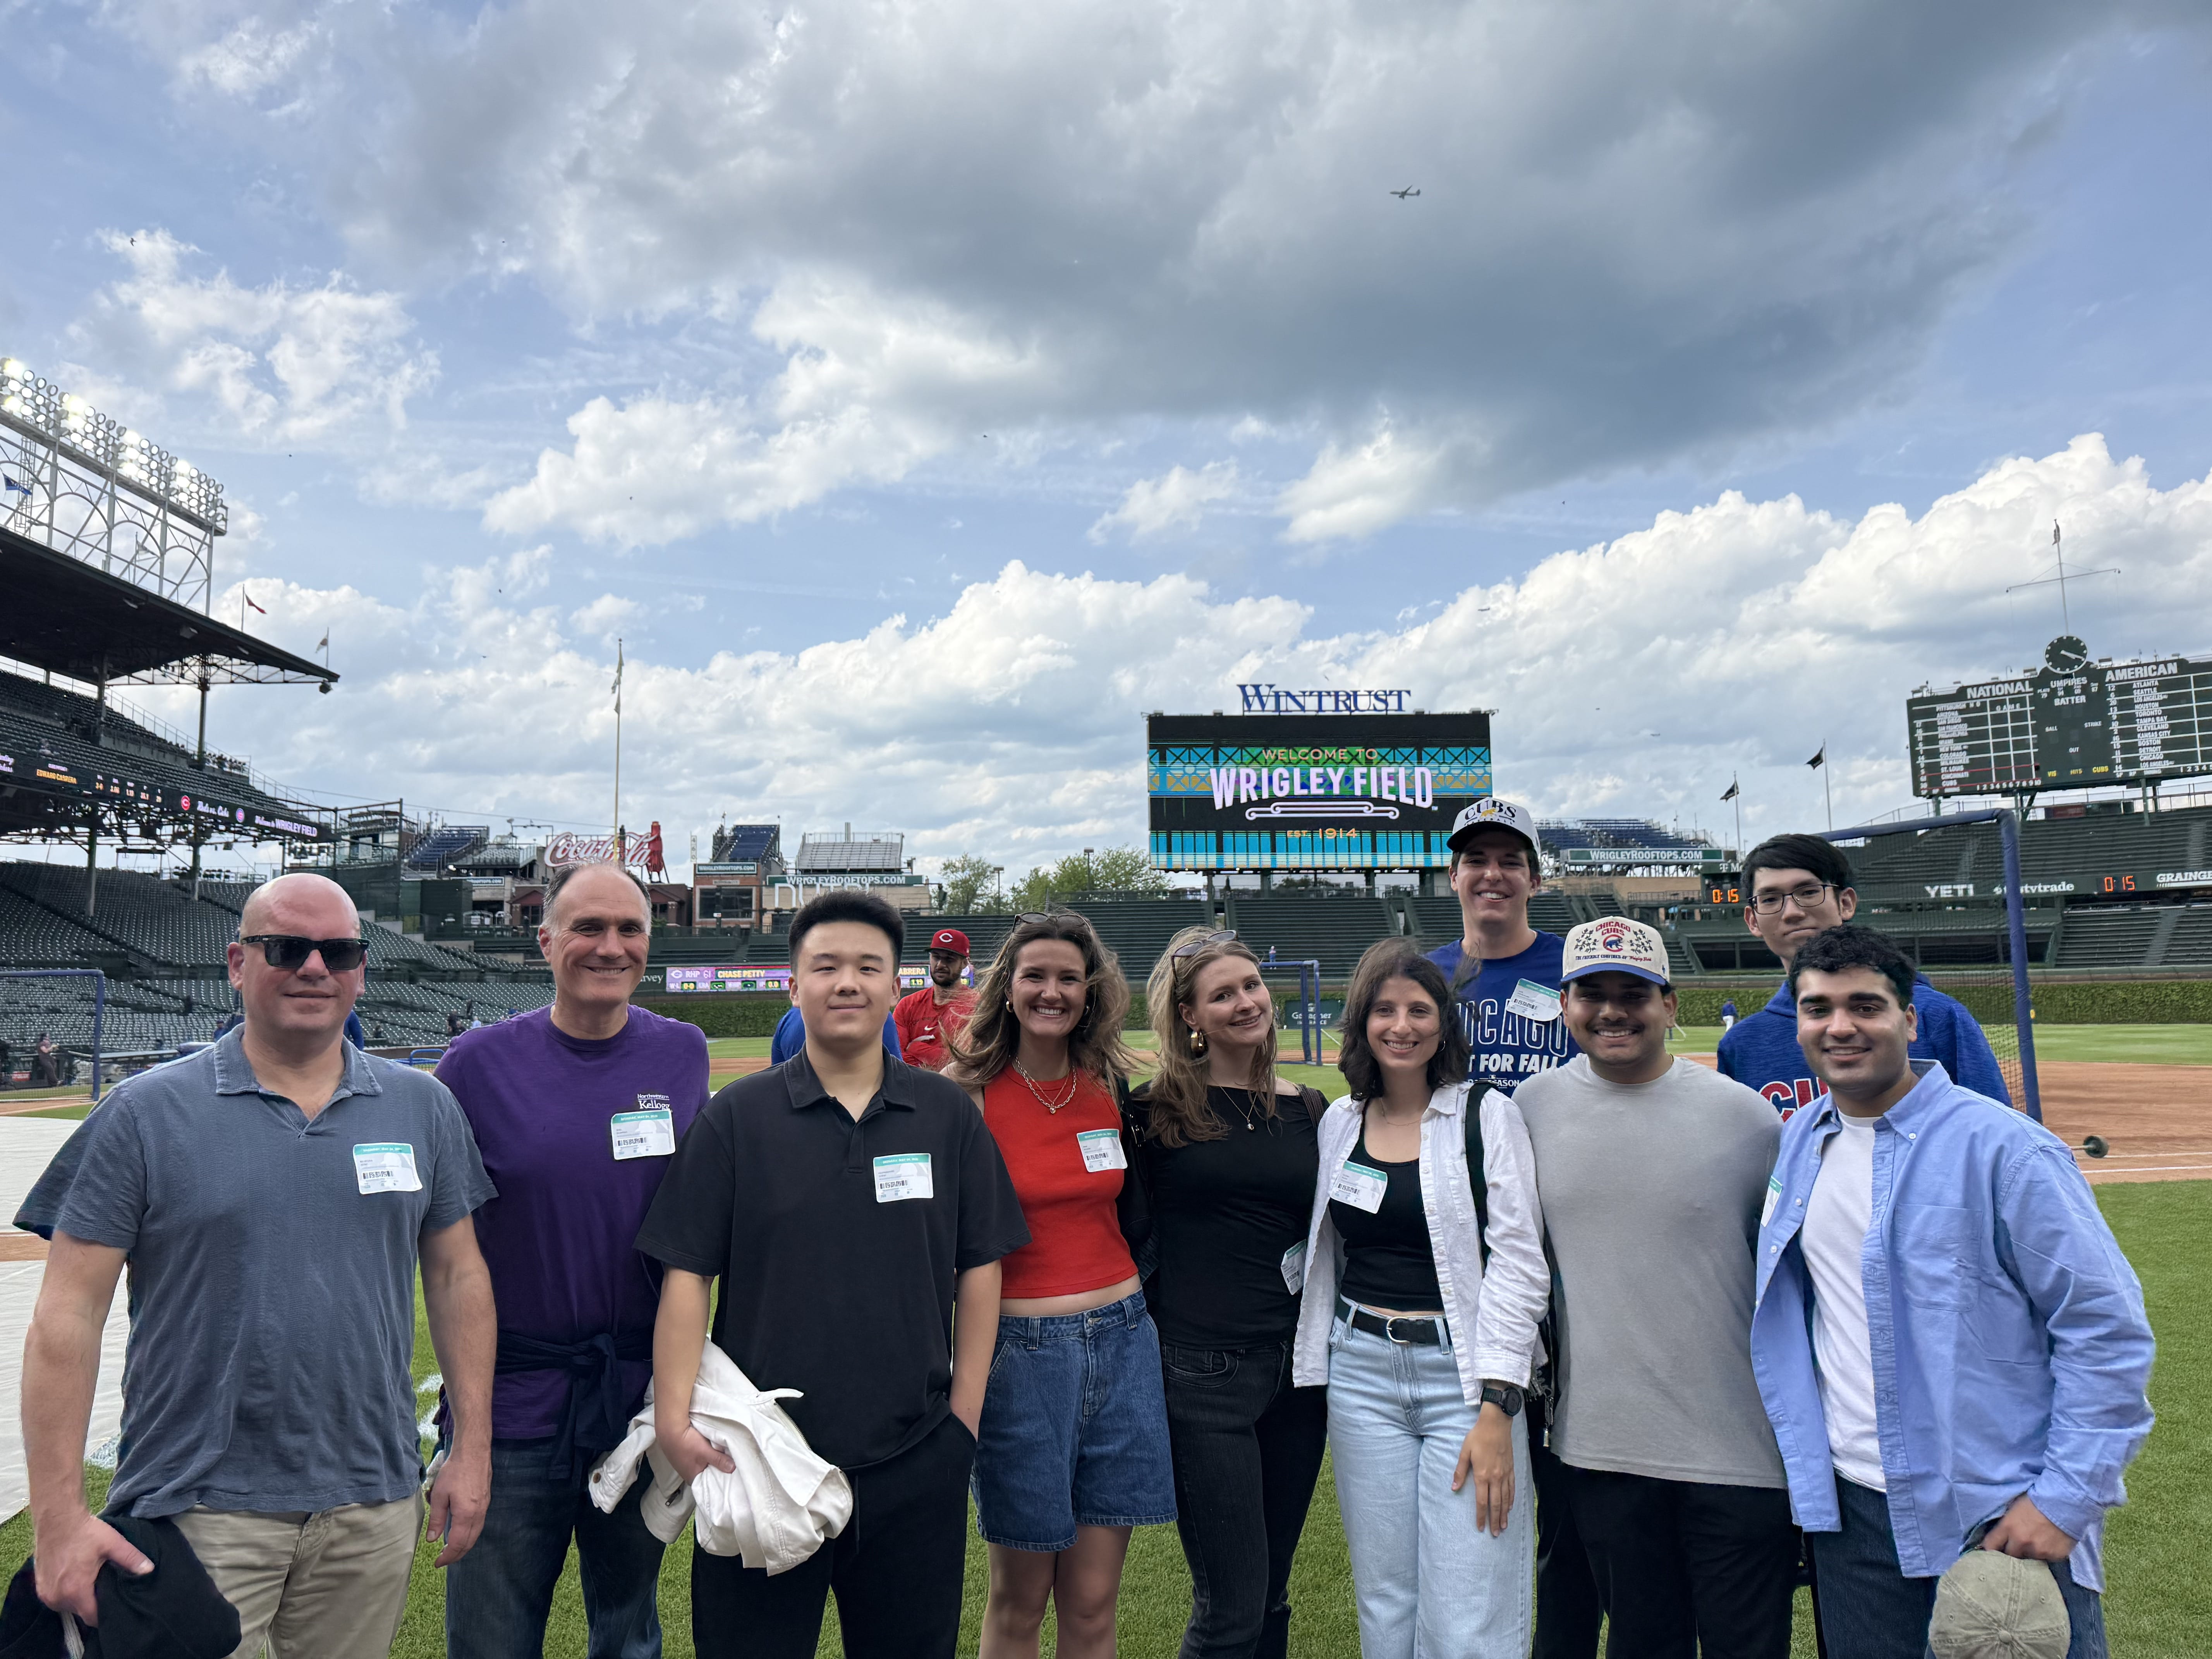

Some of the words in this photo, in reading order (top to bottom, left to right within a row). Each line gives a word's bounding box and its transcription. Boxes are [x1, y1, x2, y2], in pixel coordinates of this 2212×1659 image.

[2105, 662, 2178, 682] AMERICAN
[2050, 677, 2088, 688] UMPIRES
[2133, 680, 2159, 688] ATLANTA
[1967, 680, 2033, 699] NATIONAL
[1237, 684, 1411, 713] WINTRUST
[2054, 695, 2086, 706] BATTER
[2135, 702, 2159, 710] HOUSTON
[2136, 709, 2162, 718] TORONTO
[2137, 723, 2169, 732] CLEVELAND
[1262, 749, 1348, 760] WELCOME
[1356, 748, 1378, 760] TO
[36, 769, 56, 780] EDWARD
[1210, 767, 1345, 810] WRIGLEY
[1354, 766, 1433, 809] FIELD
[1465, 800, 1516, 820] CUBS
[275, 818, 301, 833] WRIGLEY
[301, 824, 318, 837] FIELD
[1319, 828, 1358, 839] 1914
[544, 832, 658, 867] Coca-Cla
[1589, 850, 1702, 860] WRIGLEYROOFTOPS.COM
[786, 876, 905, 884] WRIGLEYROOFTOPS.COM
[1712, 888, 1740, 903] 0:15
[1925, 884, 1974, 898] YETI
[1595, 921, 1631, 933] CHICAGO
[1601, 928, 1625, 936] CUBS
[718, 970, 742, 978] CHASE
[743, 970, 765, 978] PETTY
[1456, 998, 1568, 1058] ICAGO
[1479, 1053, 1514, 1072] FOR
[1518, 1054, 1559, 1073] FALL
[638, 1100, 670, 1110] Kellogg
